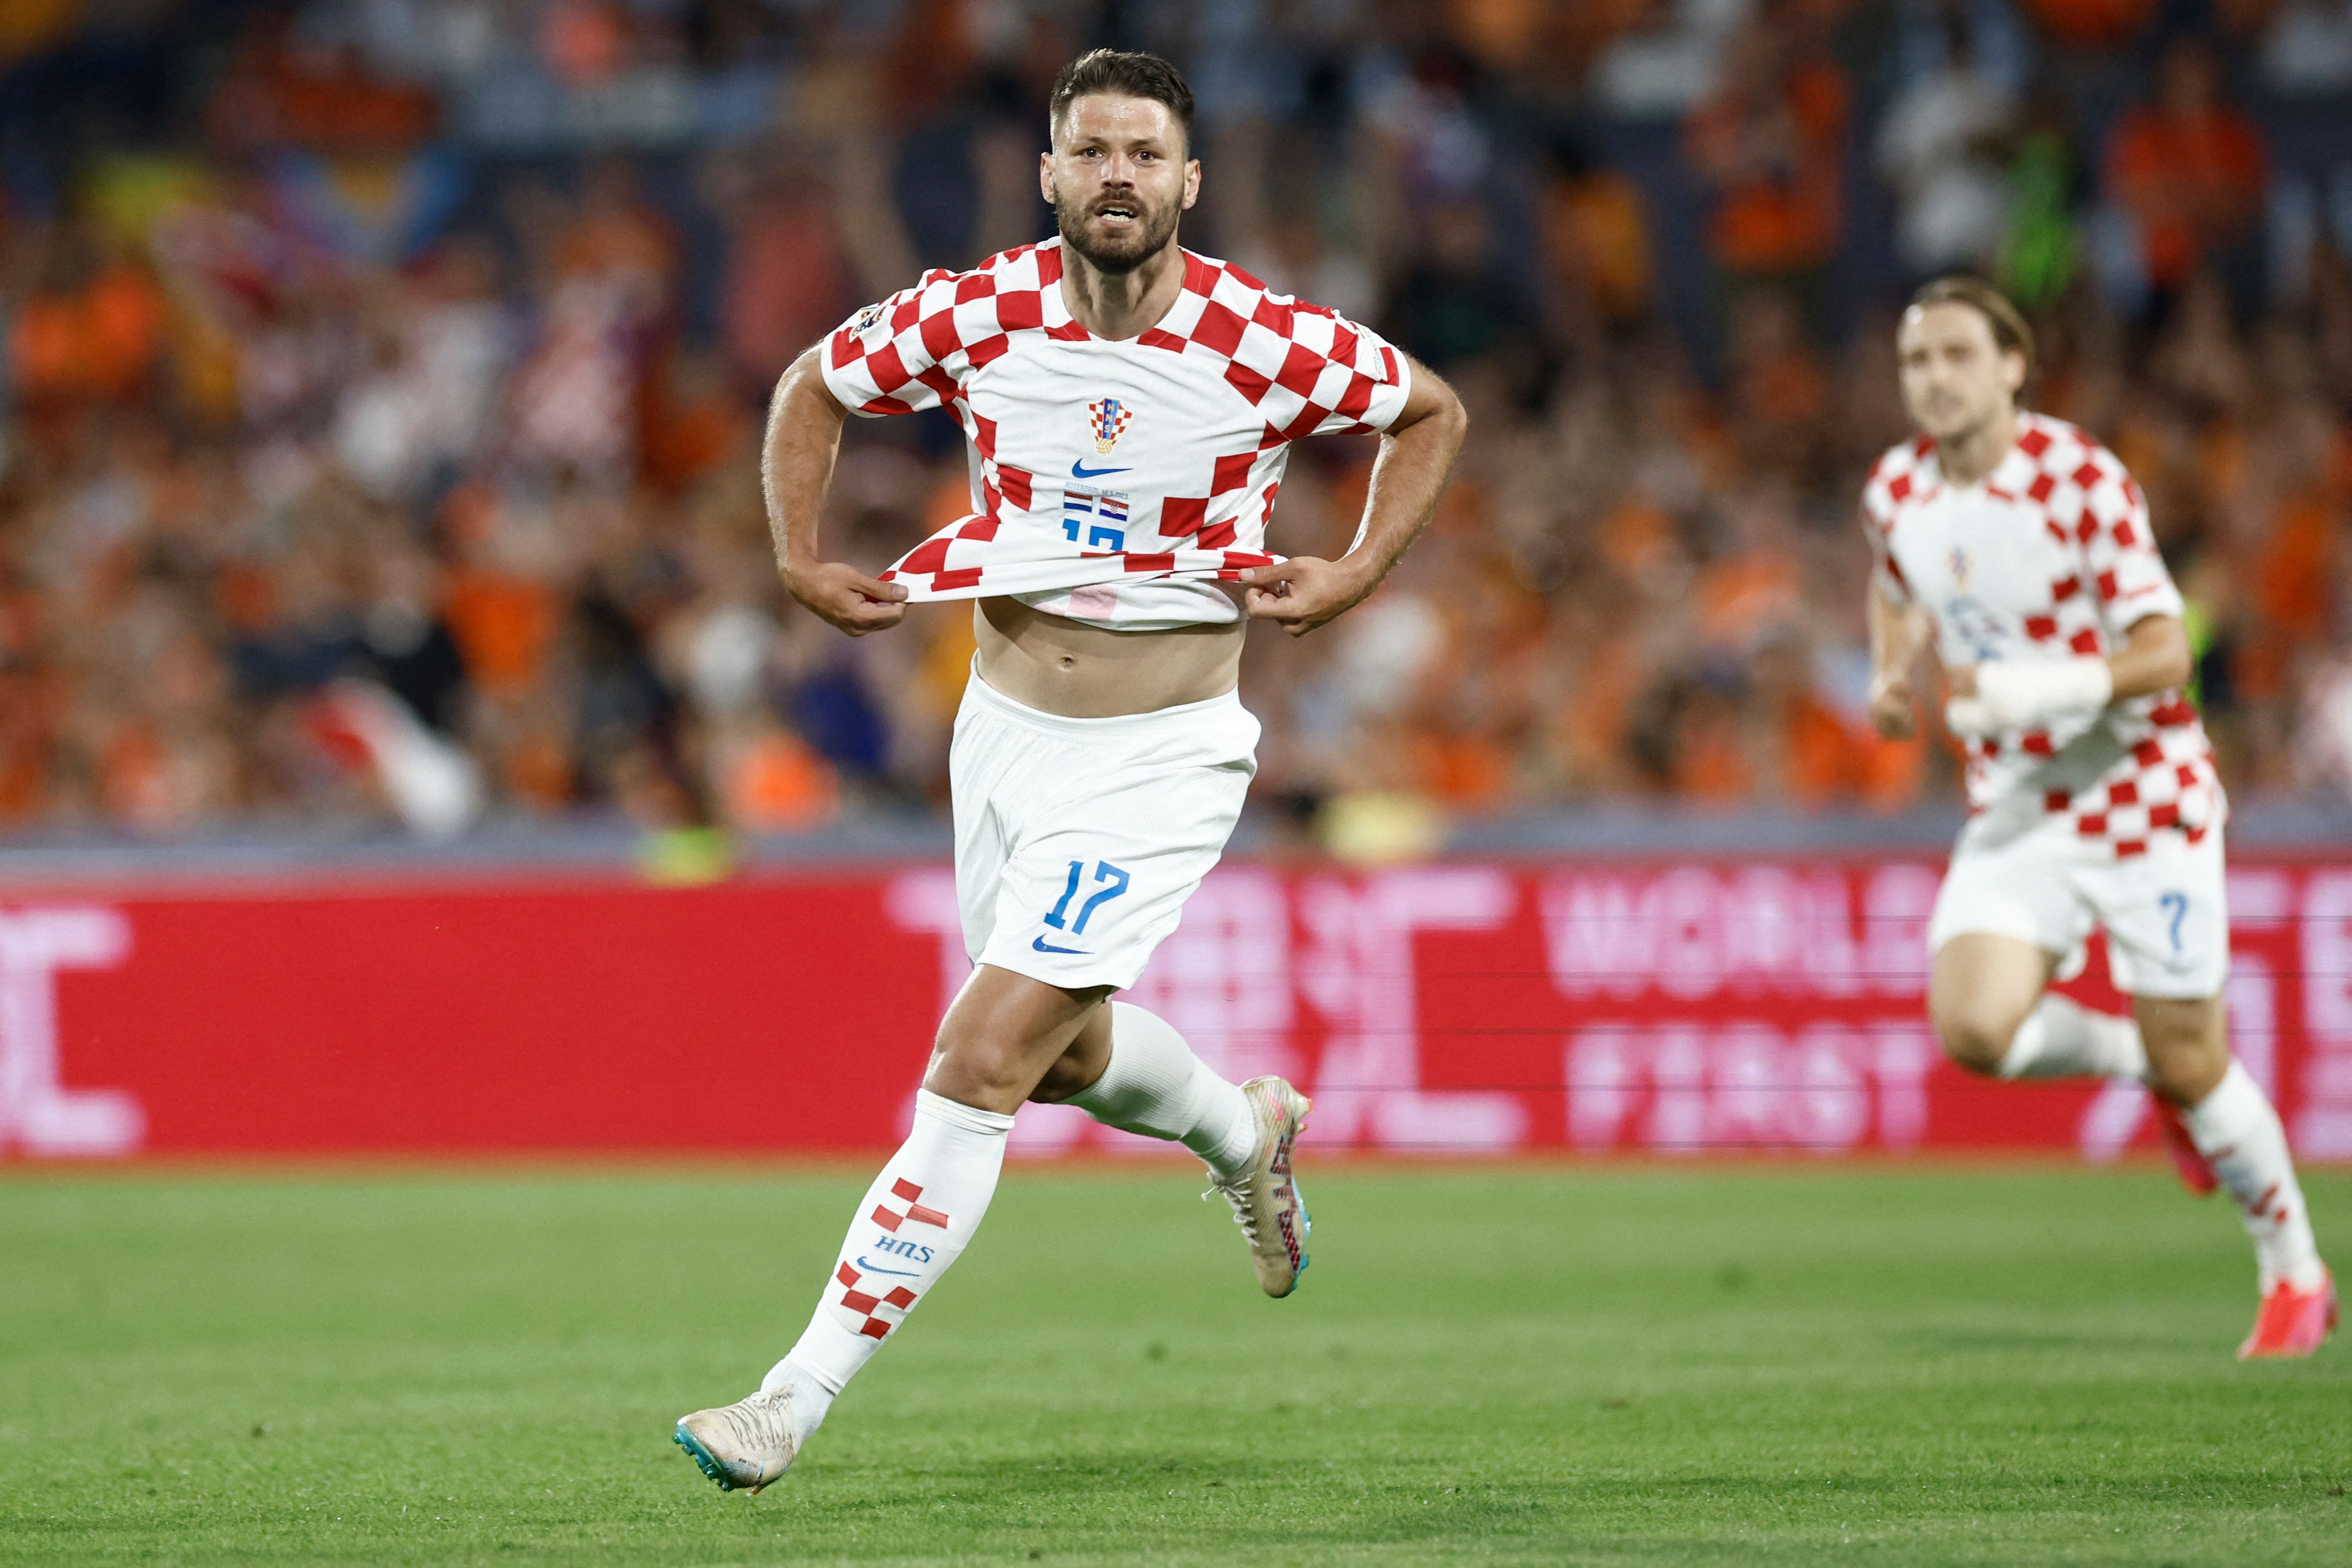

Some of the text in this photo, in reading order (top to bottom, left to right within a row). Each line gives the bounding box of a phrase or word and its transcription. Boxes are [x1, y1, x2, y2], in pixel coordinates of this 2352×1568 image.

[1043, 860, 1131, 936] 17
[2159, 891, 2188, 952] 7
[1563, 1018, 1934, 1155] FIRST
